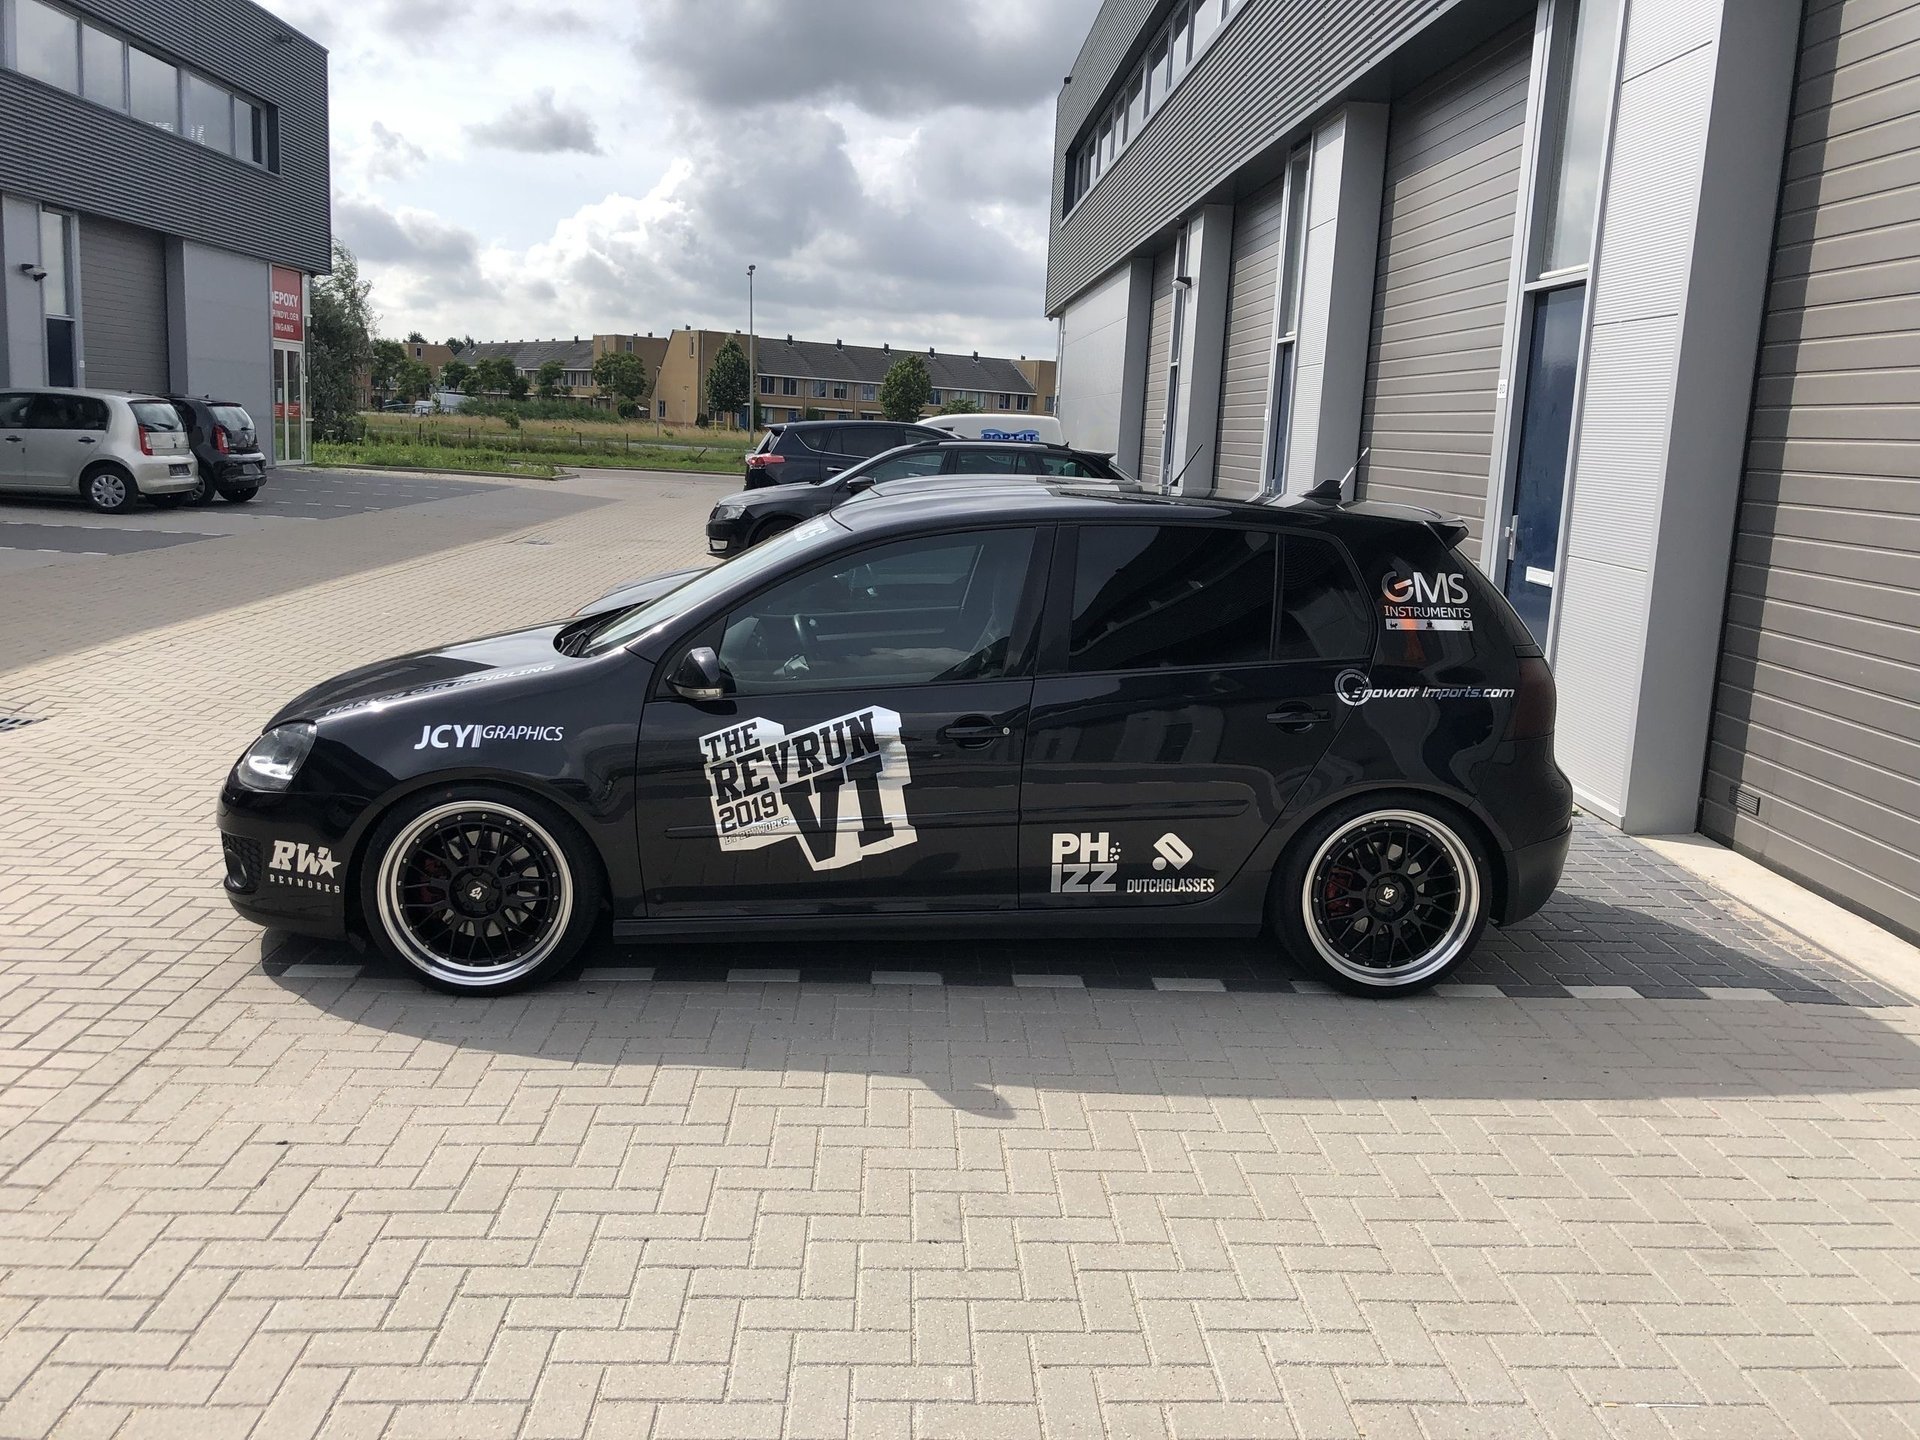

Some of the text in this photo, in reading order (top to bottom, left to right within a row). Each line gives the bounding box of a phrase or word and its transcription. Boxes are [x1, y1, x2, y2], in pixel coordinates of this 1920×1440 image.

[1381, 571, 1469, 604] GMS
[1384, 605, 1471, 619] INSTRUMENTS
[483, 725, 565, 741] GRAPHICS
[704, 722, 761, 763] THE
[710, 711, 881, 807] REVRUN
[718, 791, 779, 834] 2019
[779, 754, 895, 863] VI
[269, 874, 341, 893] REVWORKS
[1127, 878, 1215, 893] DUTCHGLASSES
